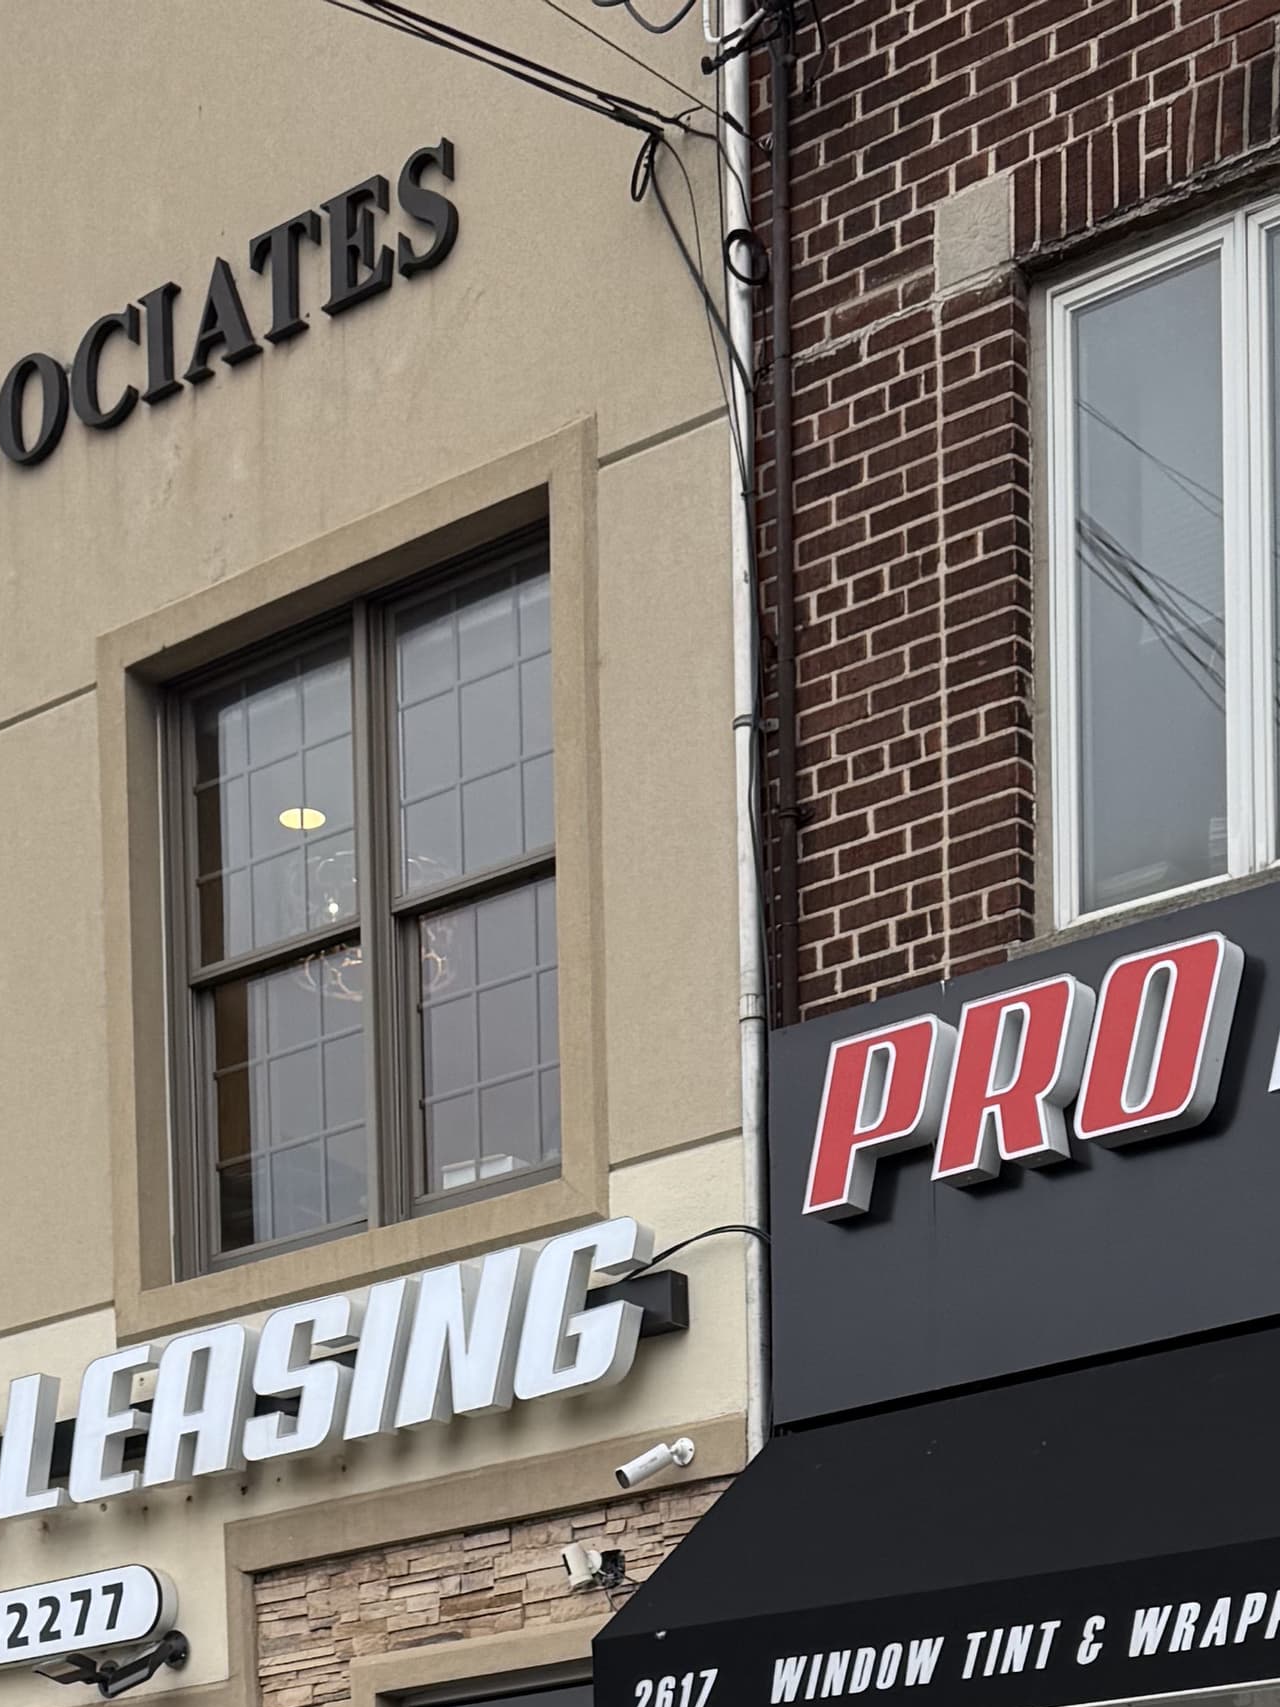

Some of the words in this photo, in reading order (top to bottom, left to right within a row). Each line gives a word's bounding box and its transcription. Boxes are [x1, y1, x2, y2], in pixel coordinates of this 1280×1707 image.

[802, 934, 1245, 1222] PRO
[771, 1636, 944, 1706] WINDOW
[961, 1620, 1061, 1680] TINT
[1077, 1615, 1105, 1664] &
